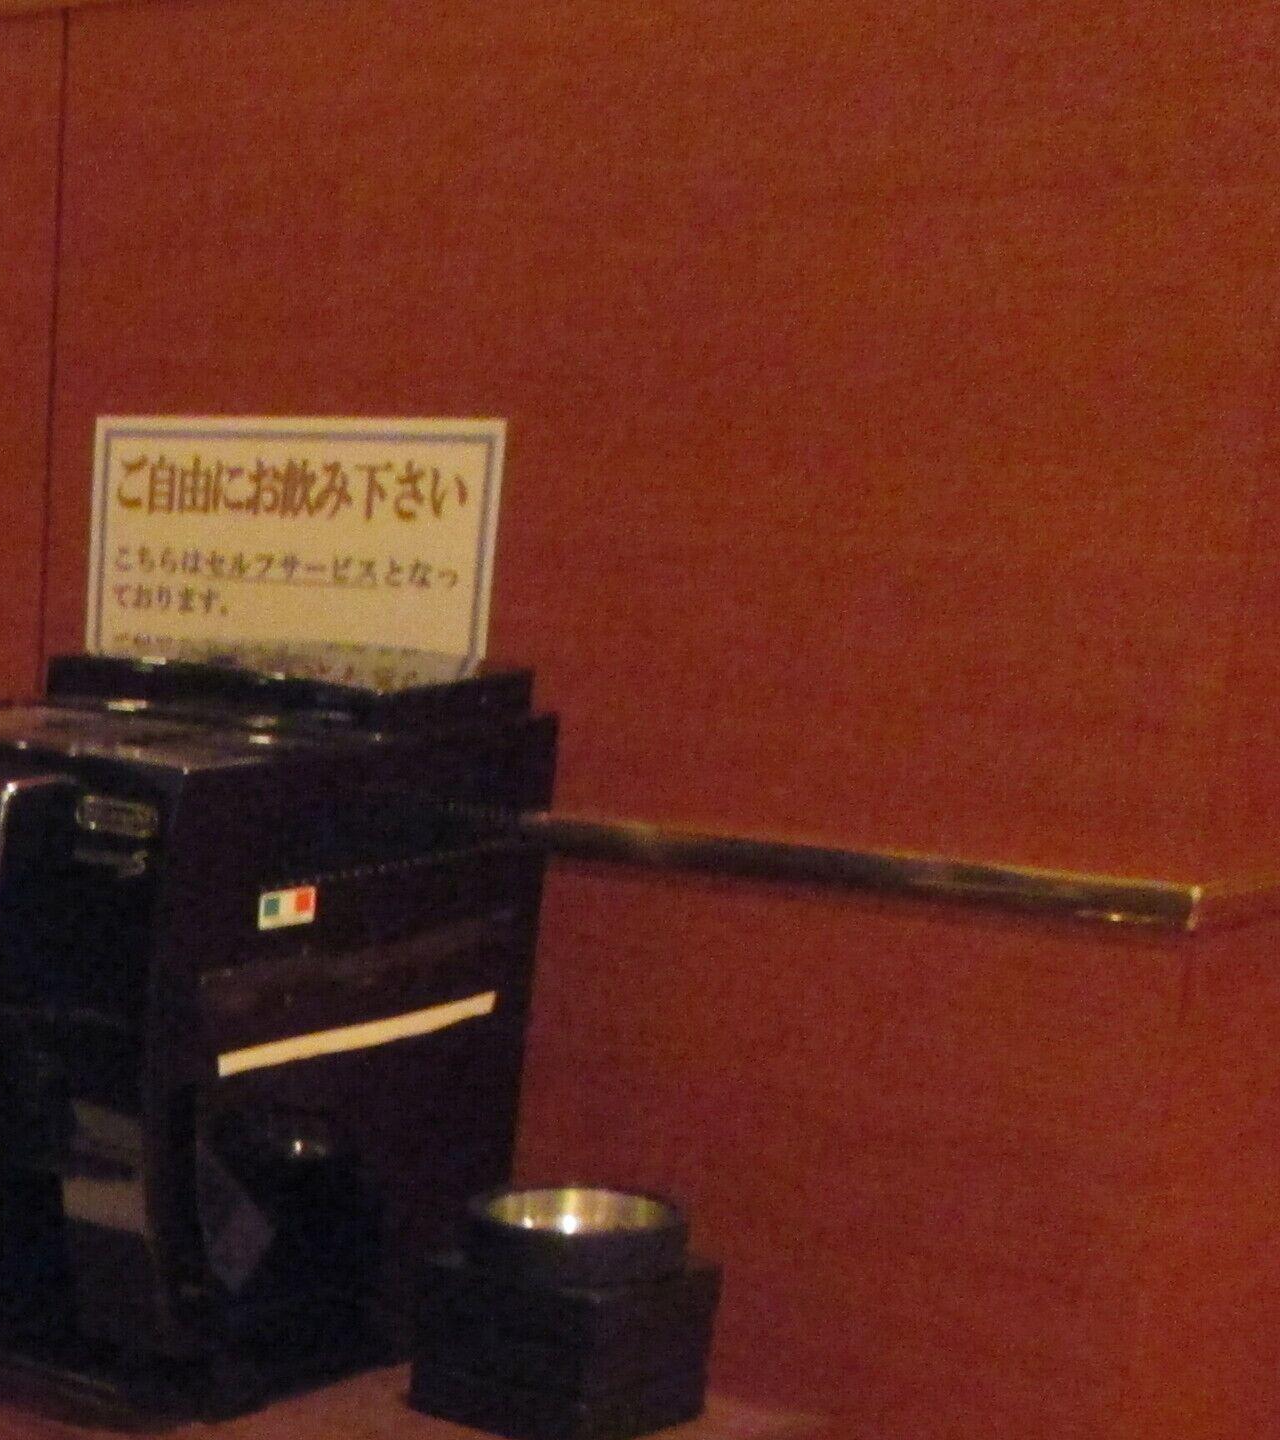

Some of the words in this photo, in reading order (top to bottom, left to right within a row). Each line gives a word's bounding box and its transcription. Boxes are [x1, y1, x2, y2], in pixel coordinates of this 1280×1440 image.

[117, 454, 468, 521] ご自由にお飲み下さい
